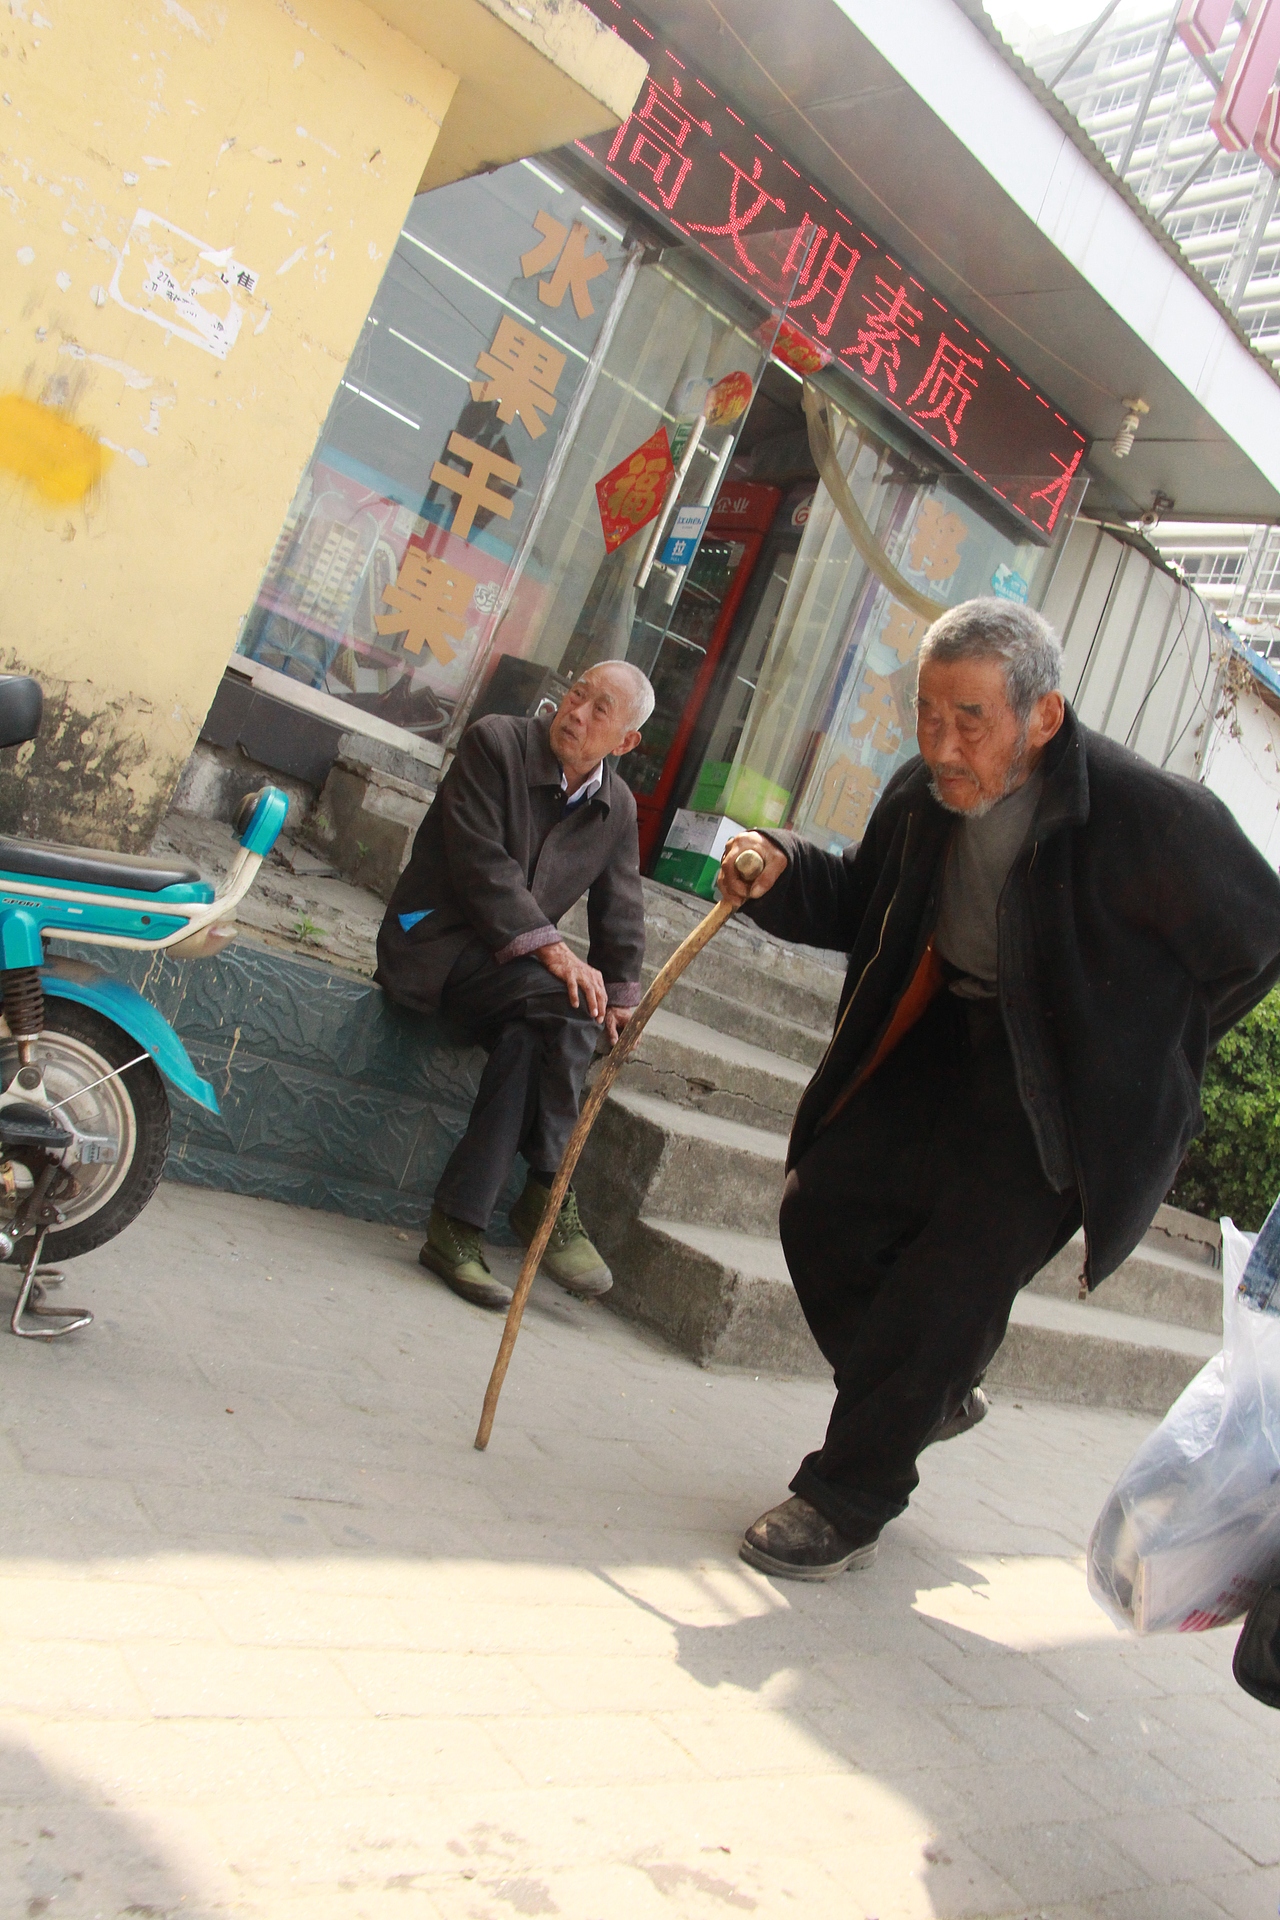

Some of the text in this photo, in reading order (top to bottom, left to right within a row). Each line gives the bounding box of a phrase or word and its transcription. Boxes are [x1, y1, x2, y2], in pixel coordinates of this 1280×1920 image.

[608, 77, 983, 446] 高文明素质
[375, 210, 609, 667] 水果干果
[608, 453, 667, 524] 福
[715, 497, 750, 514] 企业
[672, 540, 686, 556] 拉
[3, 898, 42, 908] SPORT
